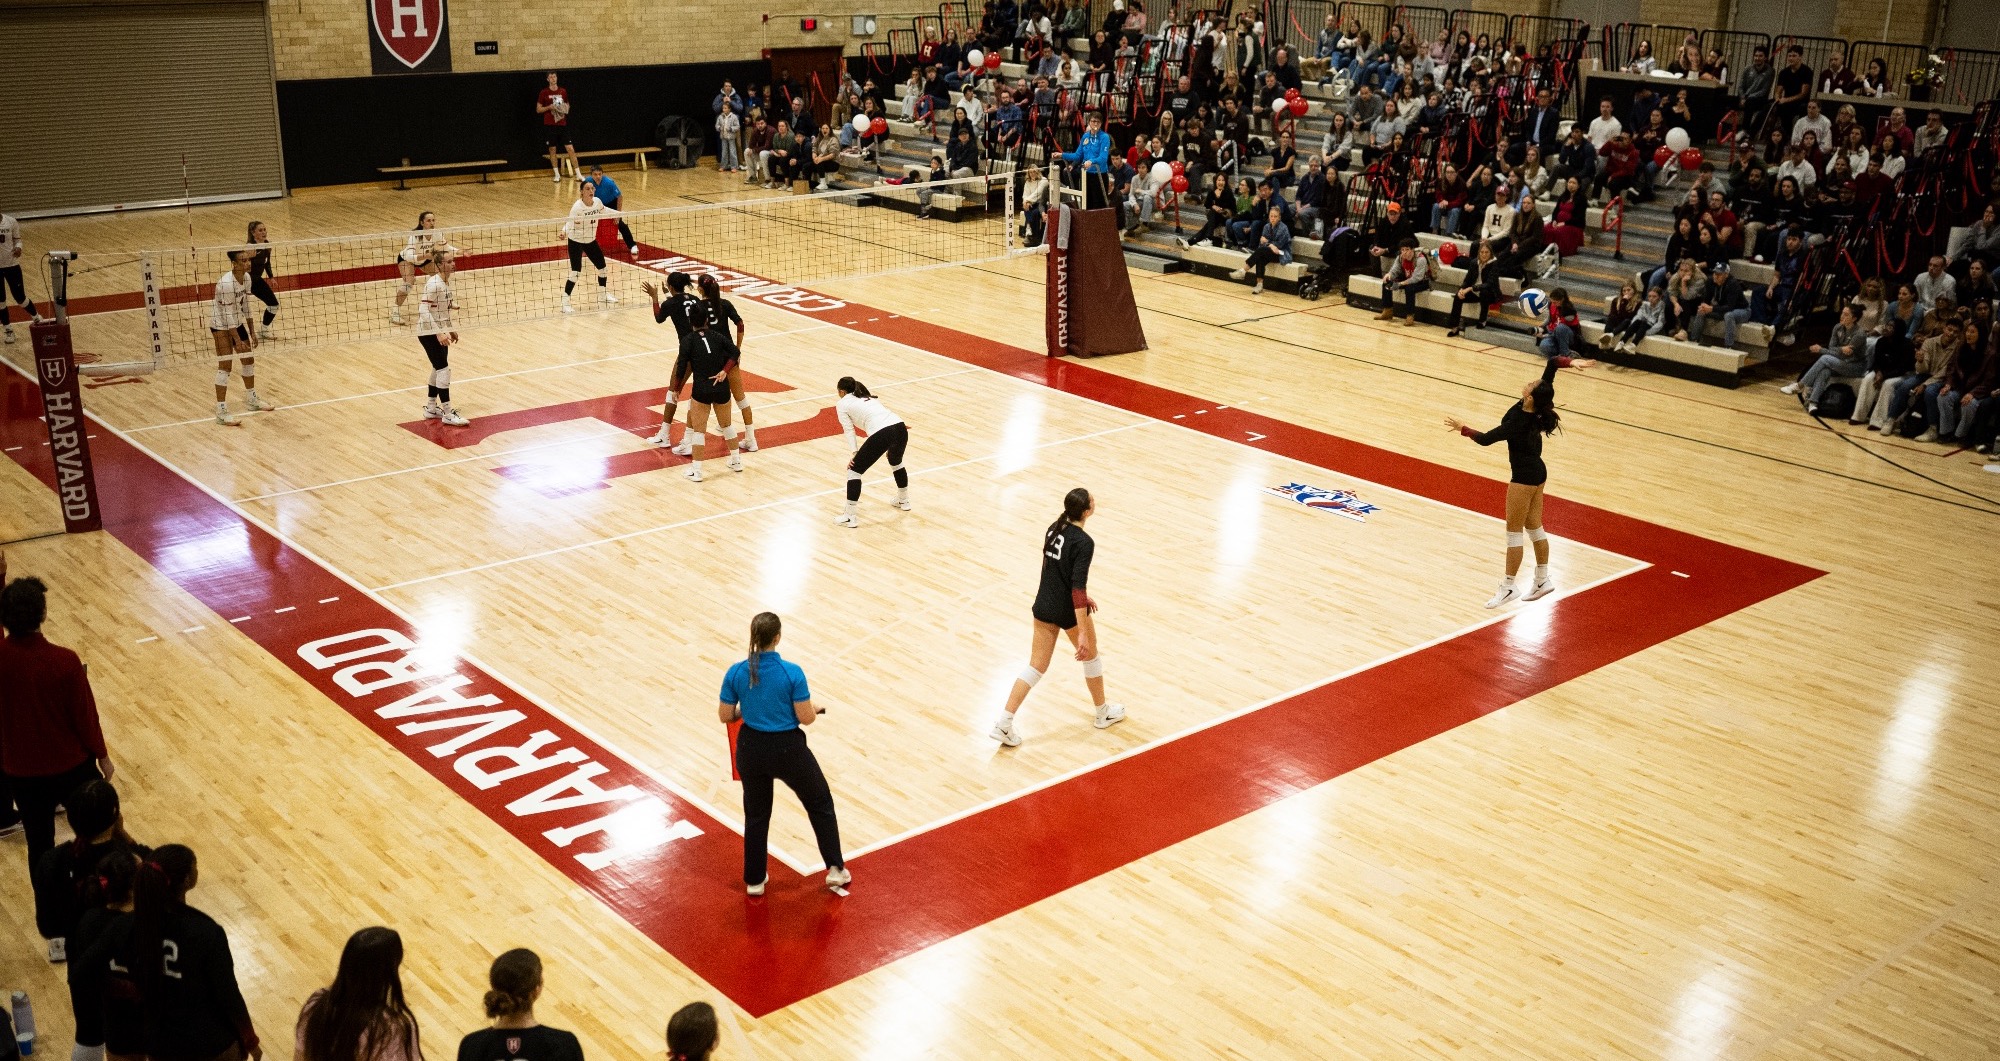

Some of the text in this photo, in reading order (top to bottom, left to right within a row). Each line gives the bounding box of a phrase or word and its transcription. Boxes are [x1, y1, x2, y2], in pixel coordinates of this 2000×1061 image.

[391, 0, 428, 38] H
[923, 45, 932, 57] H
[1492, 213, 1502, 227] H
[144, 272, 161, 353] HARVARD
[702, 337, 711, 354] 1
[46, 361, 62, 379] H
[45, 391, 90, 521] HARVARD
[296, 628, 705, 872] HARVARD
